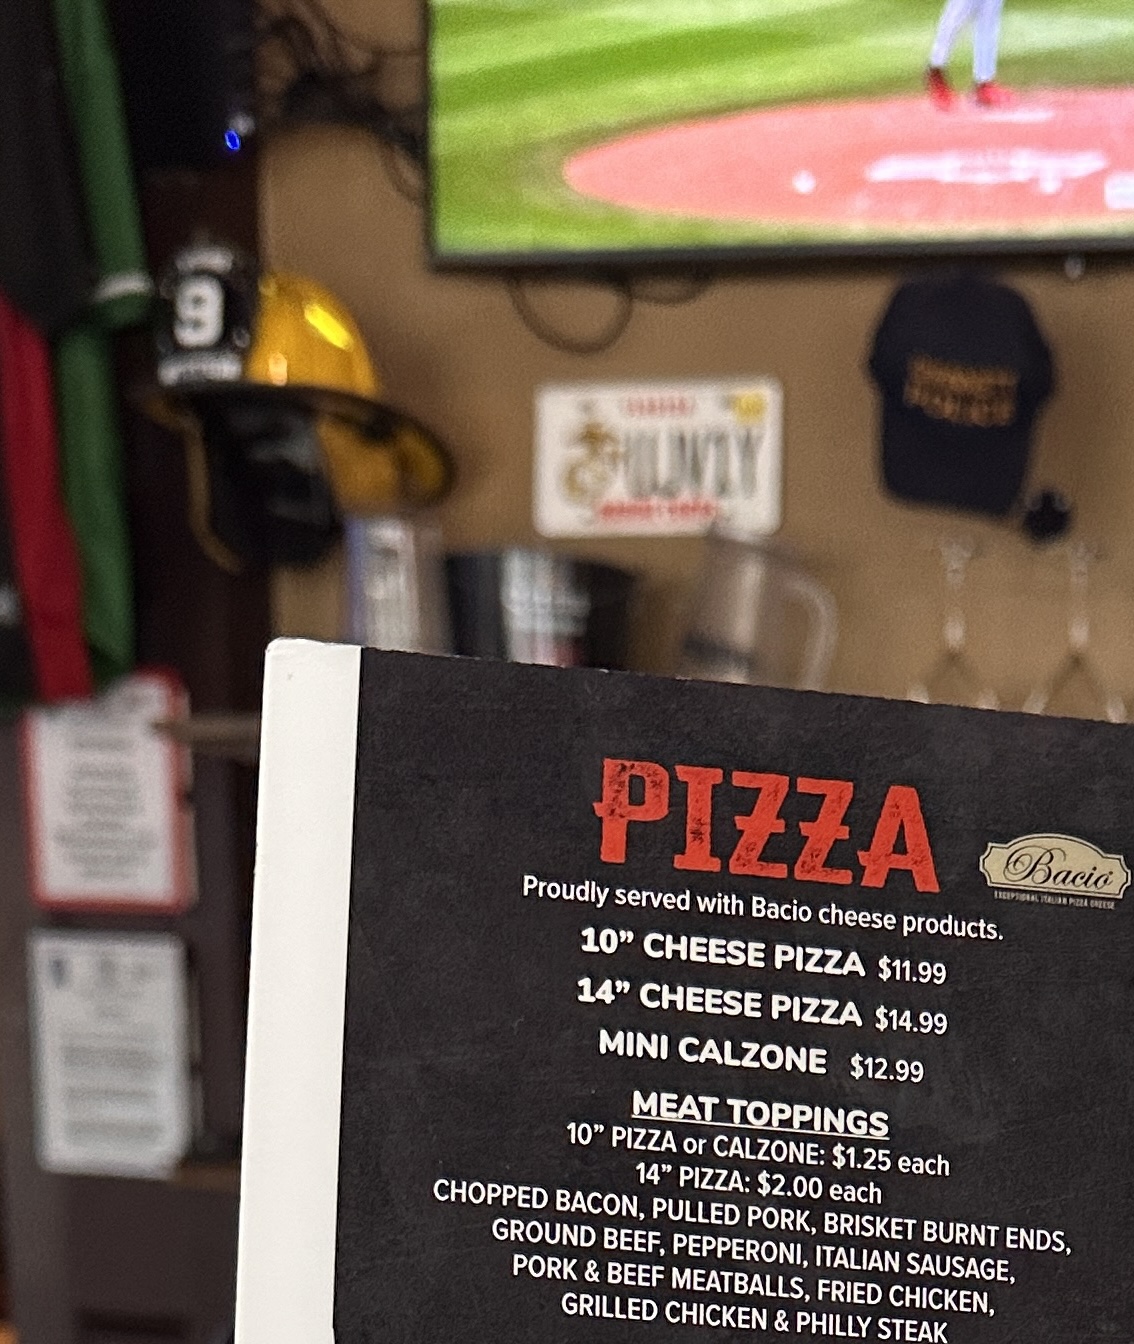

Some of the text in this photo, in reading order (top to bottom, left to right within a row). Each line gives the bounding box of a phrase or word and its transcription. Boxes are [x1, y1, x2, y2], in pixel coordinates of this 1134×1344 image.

[174, 274, 225, 349] 9
[594, 758, 940, 893] PIZZA
[1003, 845, 1115, 890] Bacio
[523, 875, 1004, 941] Proudly served with Bacio cheese products.
[643, 932, 766, 968] CHEESE
[774, 944, 866, 977] PIZZA
[878, 954, 947, 985] $11.99
[631, 1090, 890, 1141] MEAT TOPPINGS
[612, 1126, 677, 1153] PIZZA
[683, 1137, 707, 1155] or
[713, 1134, 825, 1166] CALZONE:
[832, 1142, 891, 1171] $1.25
[898, 1154, 950, 1177] each
